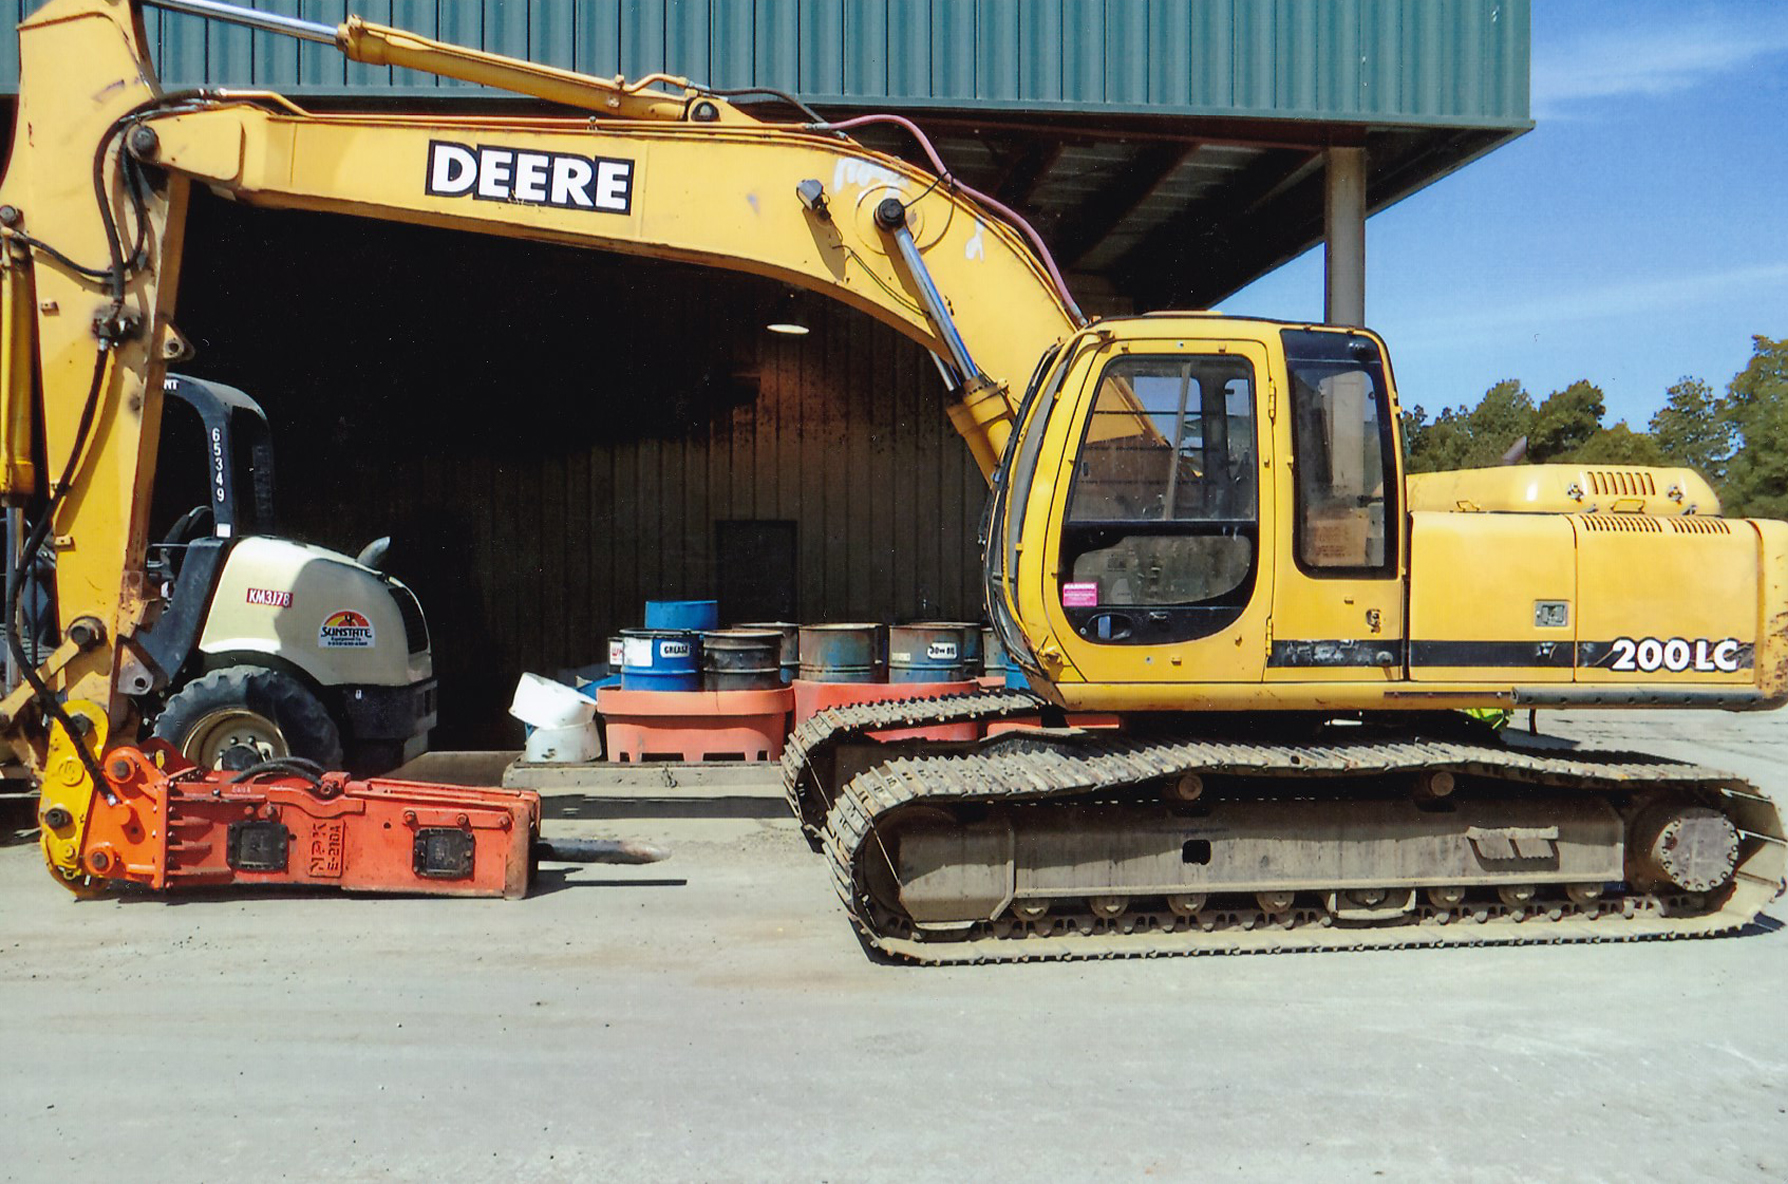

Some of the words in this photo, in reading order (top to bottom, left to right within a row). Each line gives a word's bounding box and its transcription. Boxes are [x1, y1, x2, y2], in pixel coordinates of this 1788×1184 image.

[429, 142, 632, 213] DEERE
[212, 428, 224, 502] 65349
[320, 626, 373, 639] SUNSTATE
[663, 645, 689, 655] GREASE
[1610, 637, 1739, 672] 200LC
[310, 822, 326, 872] NPK
